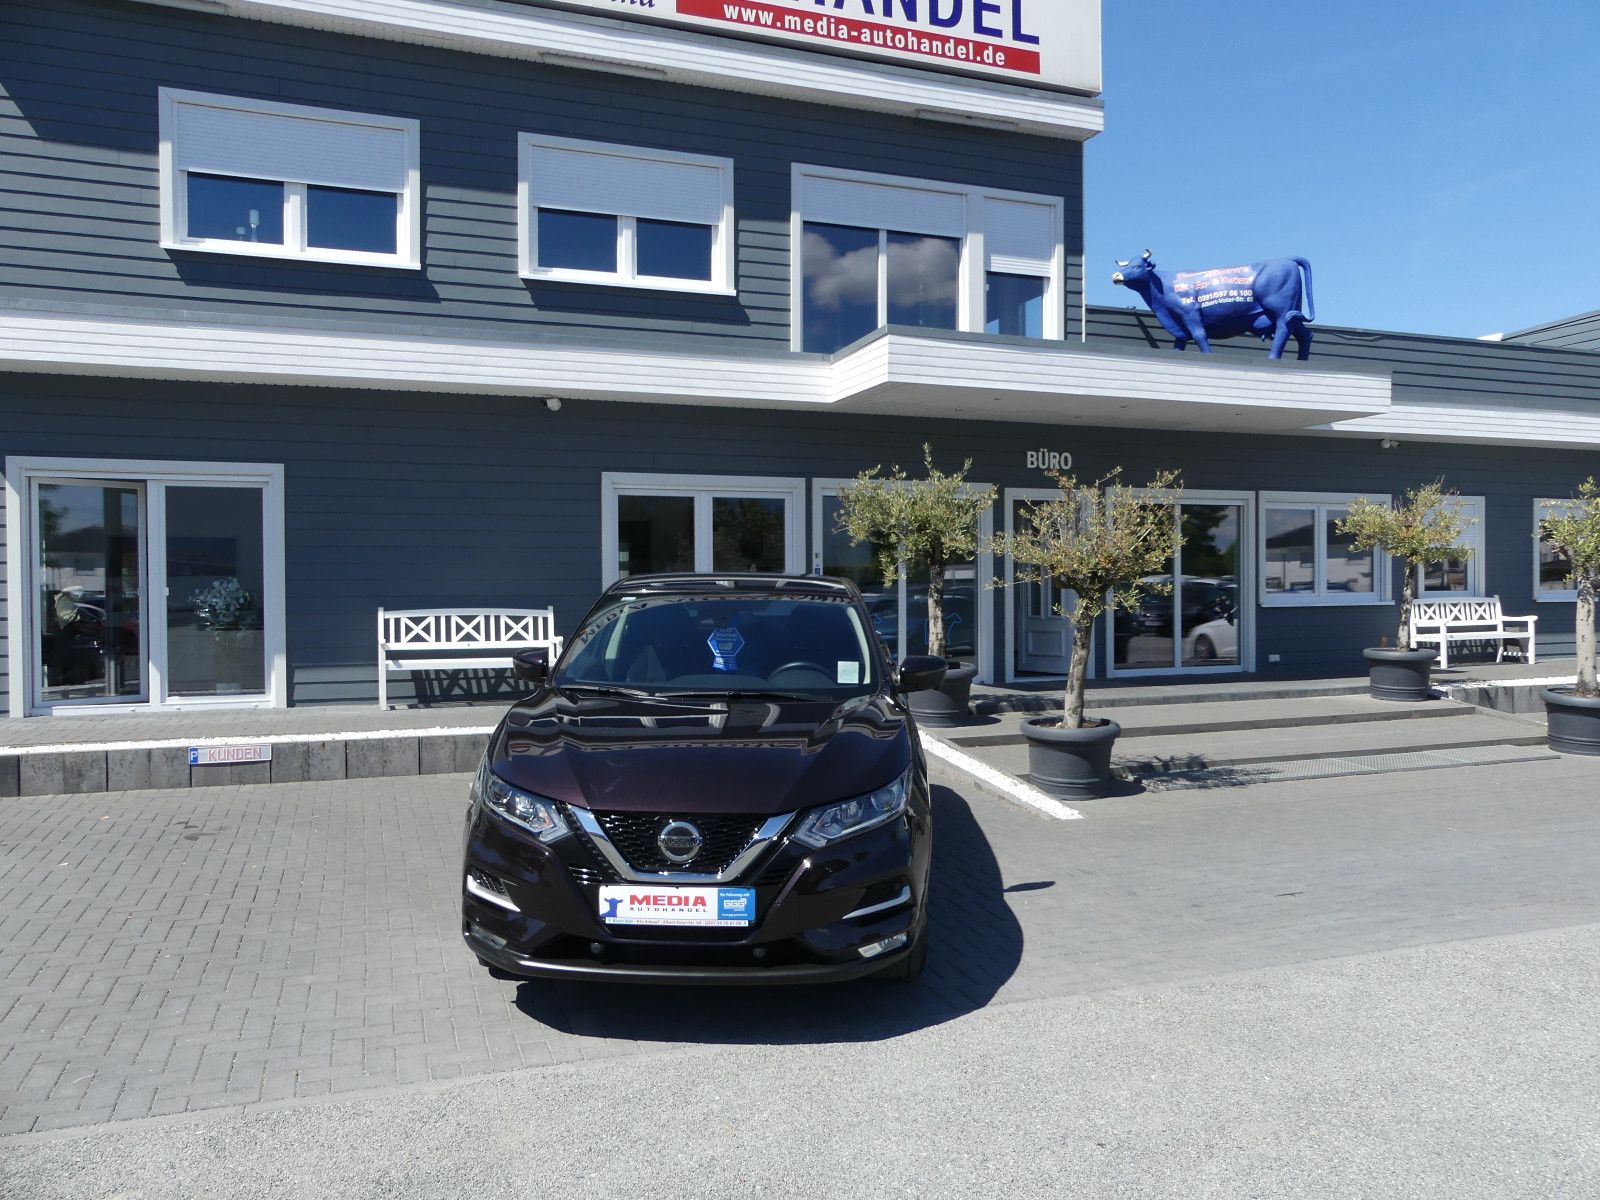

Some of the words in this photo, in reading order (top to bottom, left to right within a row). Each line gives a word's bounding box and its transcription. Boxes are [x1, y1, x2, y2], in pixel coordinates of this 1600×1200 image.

[723, 4, 1006, 66] www.media-autohandel.de
[1026, 448, 1072, 470] BÜRO
[208, 746, 262, 761] KUNDEN
[629, 895, 707, 906] MEDIA
